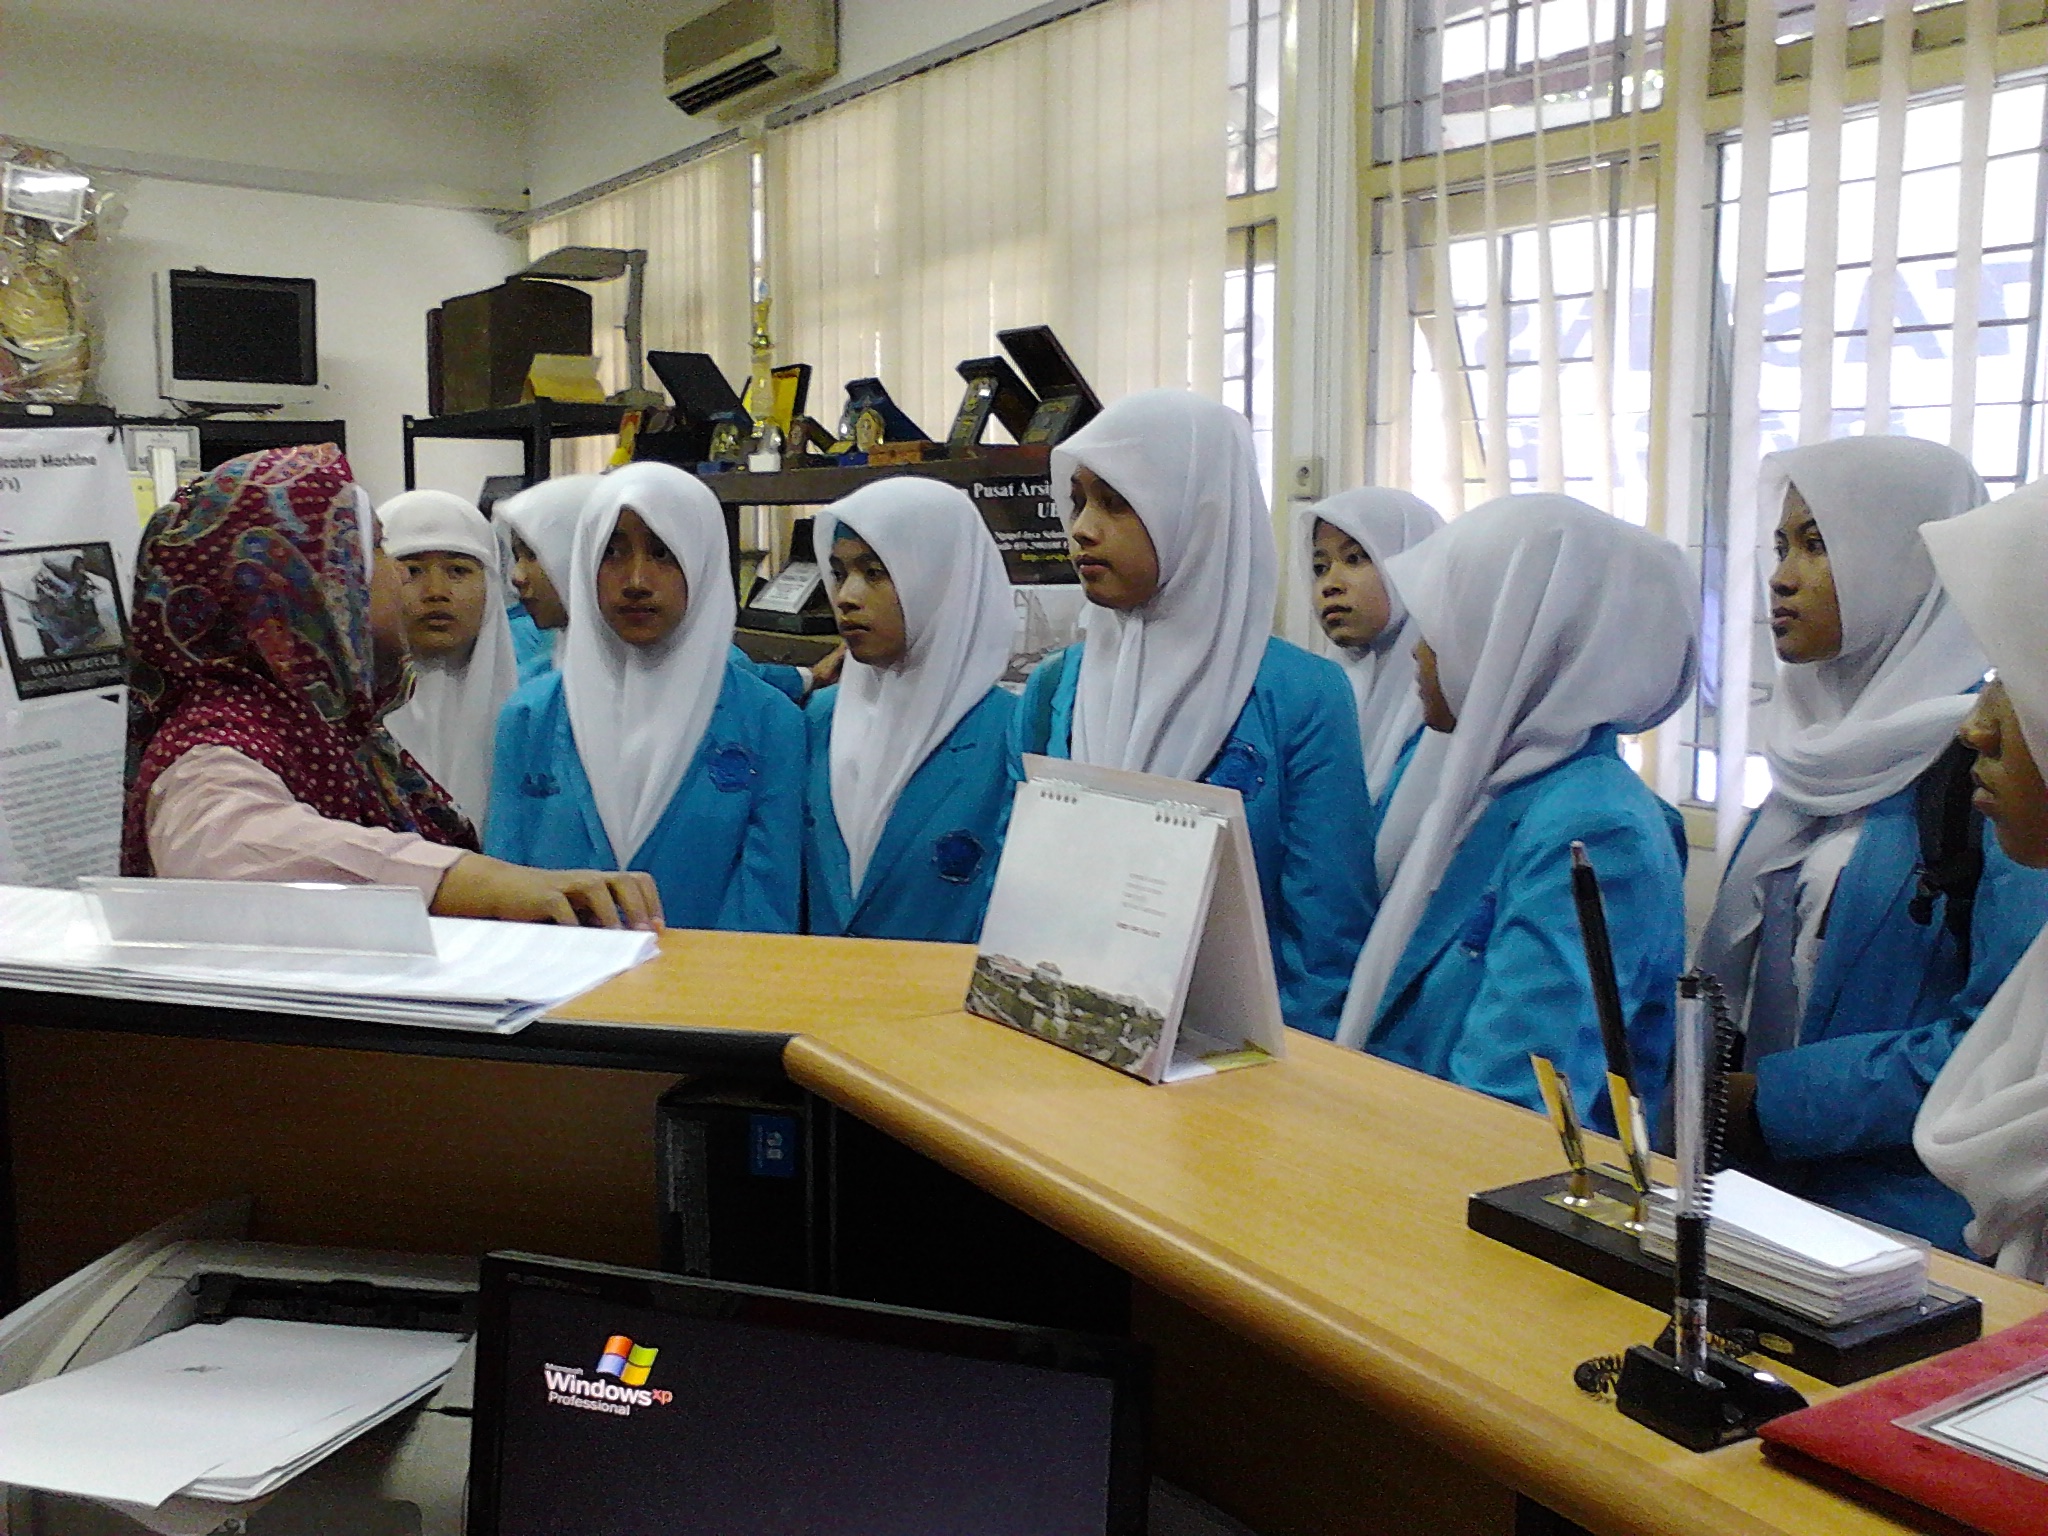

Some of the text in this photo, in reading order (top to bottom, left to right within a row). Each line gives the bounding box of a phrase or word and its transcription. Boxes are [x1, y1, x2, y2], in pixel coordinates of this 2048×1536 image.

[40, 452, 97, 467] Machine
[973, 479, 1050, 498] Pusat Arsi
[544, 1370, 652, 1407] Windows
[548, 1391, 631, 1416] Professional
